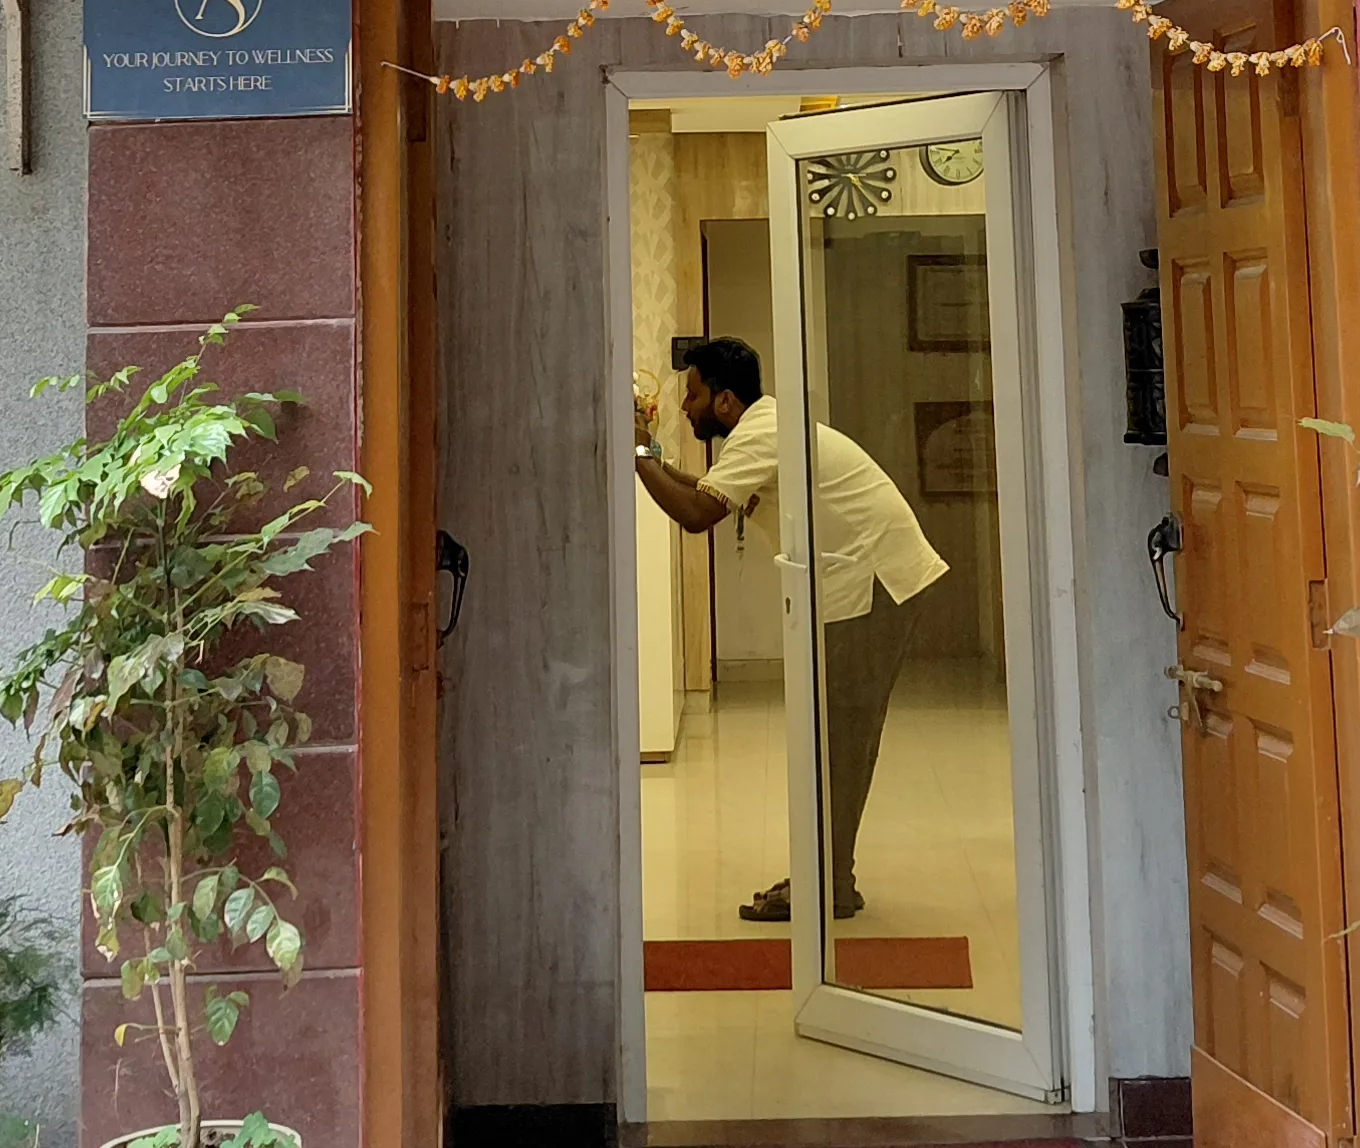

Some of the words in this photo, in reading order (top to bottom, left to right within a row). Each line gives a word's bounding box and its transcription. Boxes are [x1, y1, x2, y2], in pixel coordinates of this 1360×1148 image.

[103, 53, 148, 68] YOUR
[151, 50, 221, 70] JOURNEY
[226, 50, 248, 65] TO
[252, 48, 334, 64] WELLNESS
[163, 76, 226, 92] STARTS
[229, 75, 273, 91] HERE
